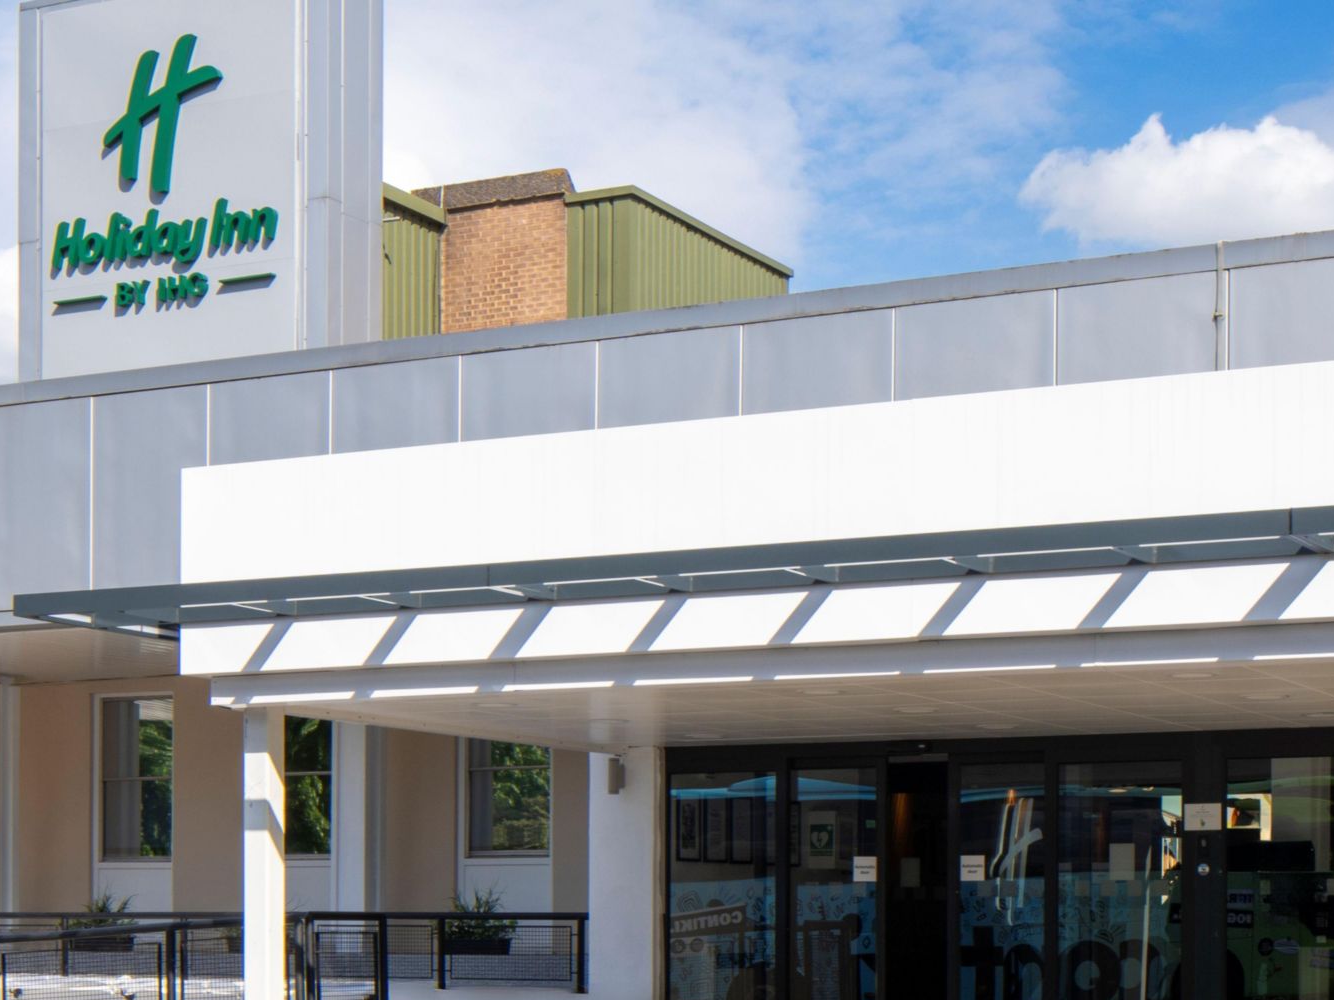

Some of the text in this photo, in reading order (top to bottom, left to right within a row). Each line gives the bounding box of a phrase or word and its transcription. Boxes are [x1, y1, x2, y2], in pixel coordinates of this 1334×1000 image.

[103, 33, 223, 195] H
[51, 197, 278, 271] Holiday Inn
[115, 271, 209, 308] BY IHG
